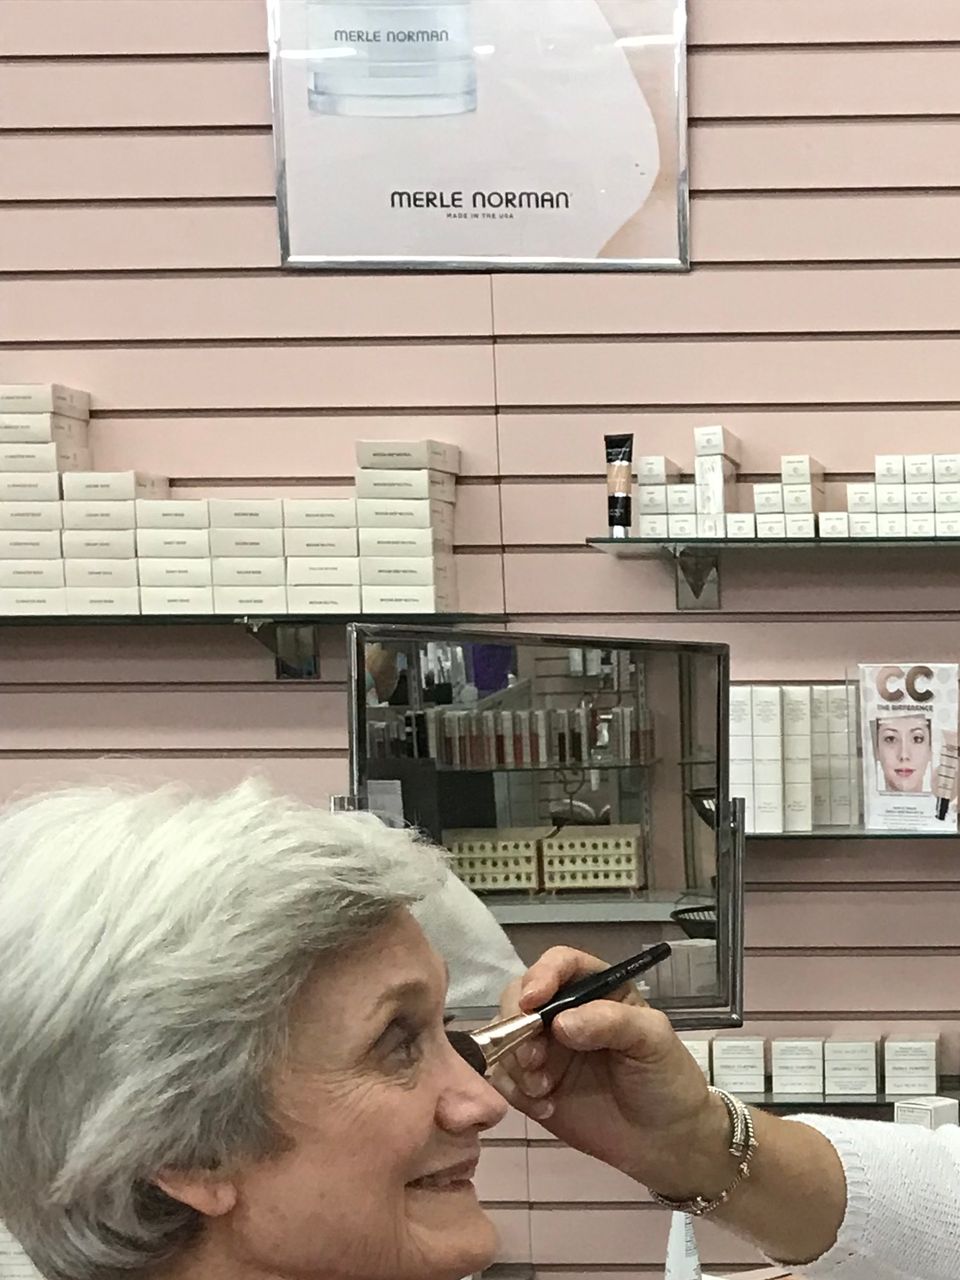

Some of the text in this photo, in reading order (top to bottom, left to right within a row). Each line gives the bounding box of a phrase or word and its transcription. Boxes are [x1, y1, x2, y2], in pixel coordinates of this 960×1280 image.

[334, 30, 449, 42] MERLE NORMAN
[390, 191, 569, 208] MERLE NORMAN
[876, 666, 934, 702] CC
